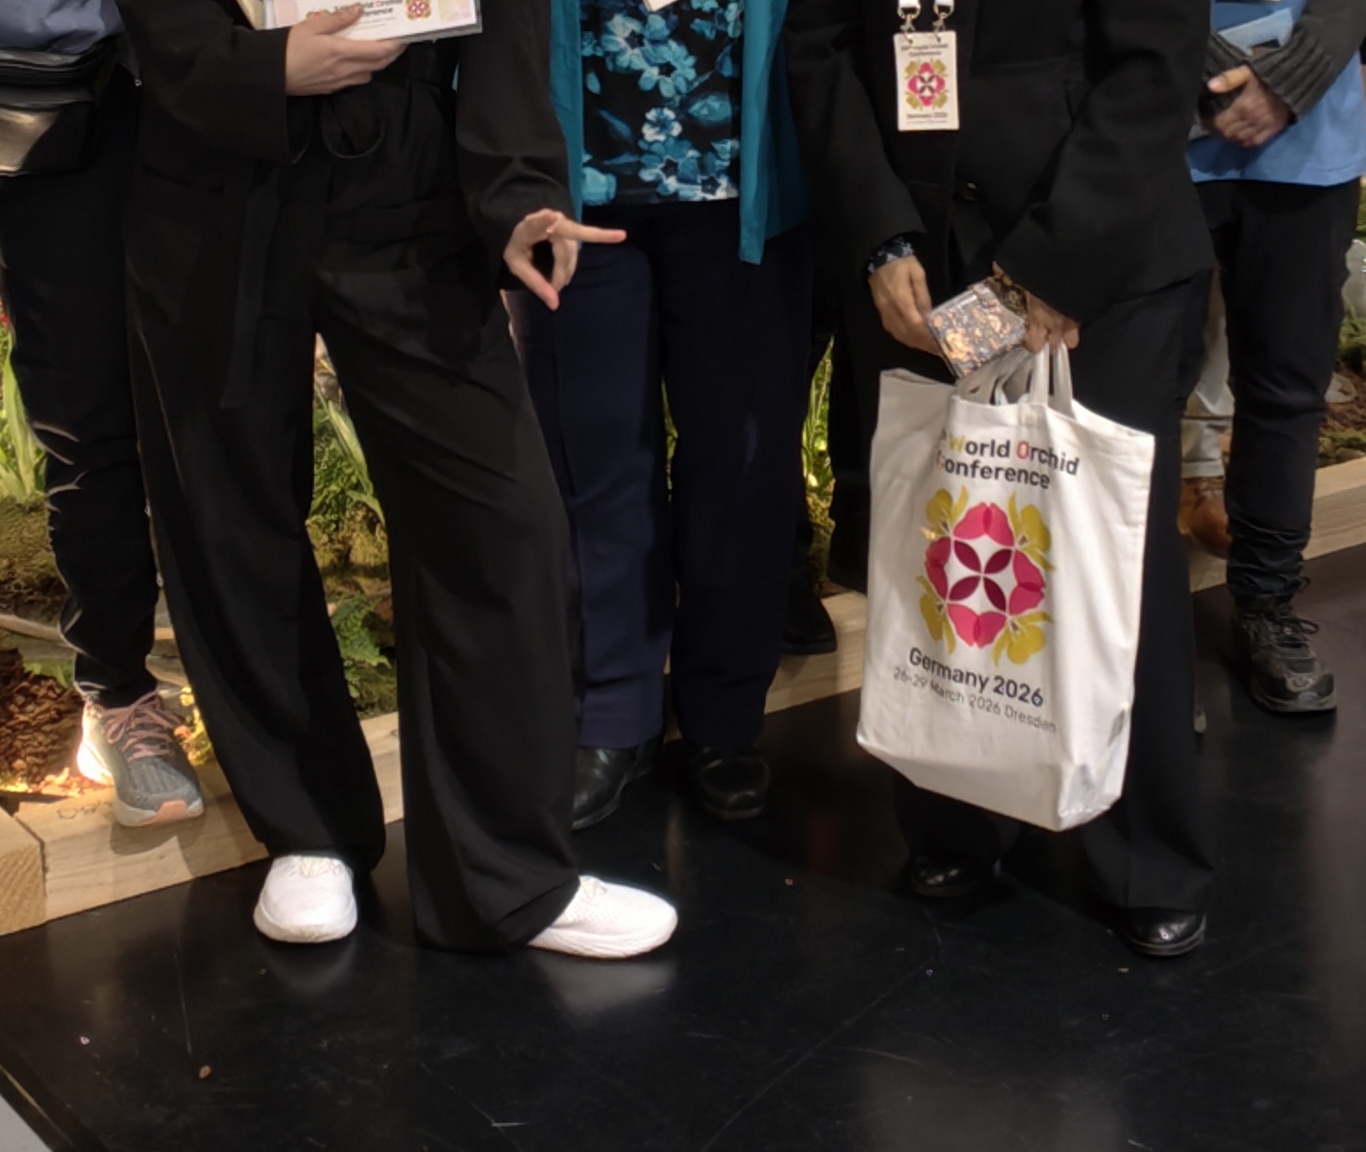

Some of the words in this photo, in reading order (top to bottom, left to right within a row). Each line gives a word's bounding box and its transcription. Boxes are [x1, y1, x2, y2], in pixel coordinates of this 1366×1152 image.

[948, 431, 1011, 459] World
[1015, 439, 1080, 476] Orchid
[892, 666, 928, 690] 26-29
[929, 679, 966, 704] March
[968, 693, 1002, 716] 2026
[1003, 704, 1057, 735] Dresden
[908, 646, 990, 695] Germany
[992, 675, 1045, 708] 2026
